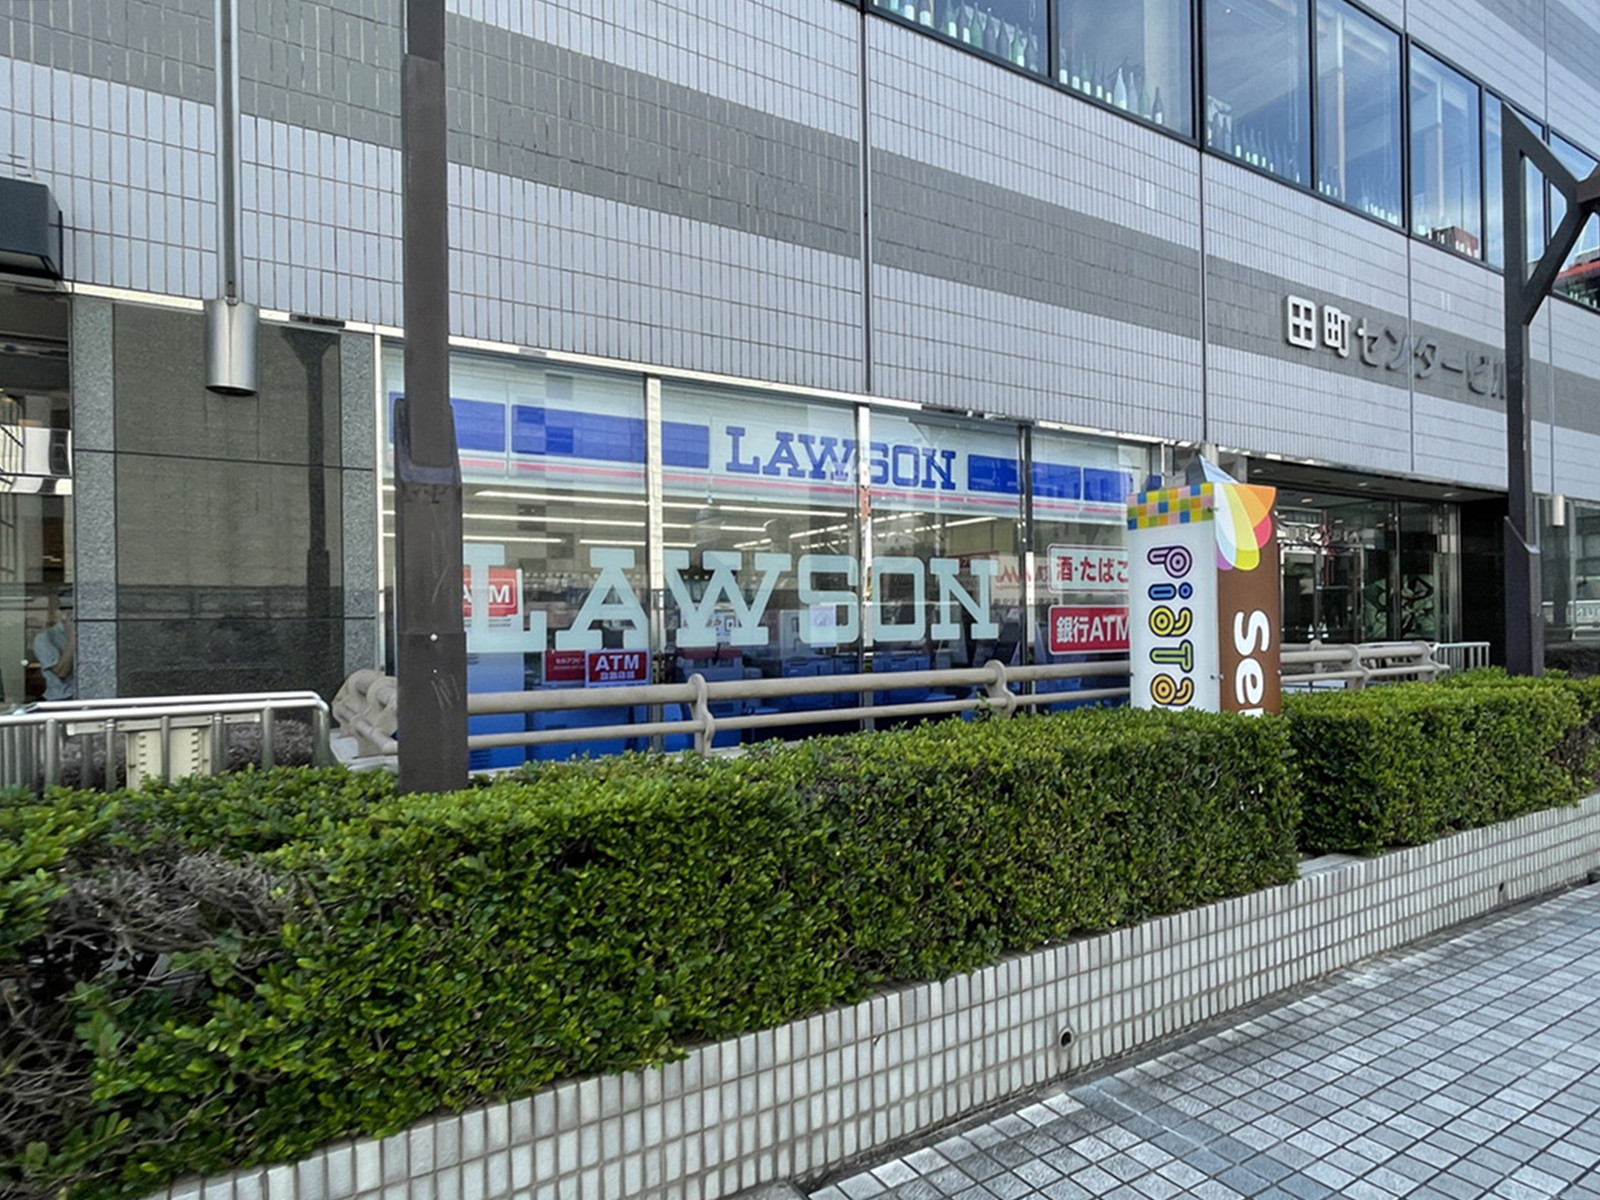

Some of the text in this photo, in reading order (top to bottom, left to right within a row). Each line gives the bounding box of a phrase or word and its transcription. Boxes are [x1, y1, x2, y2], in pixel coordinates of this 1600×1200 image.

[725, 425, 957, 491] LAWSON
[463, 542, 1000, 653] LAWSON
[1056, 615, 1131, 644] 銀行ATM
[595, 654, 640, 672] ATM
